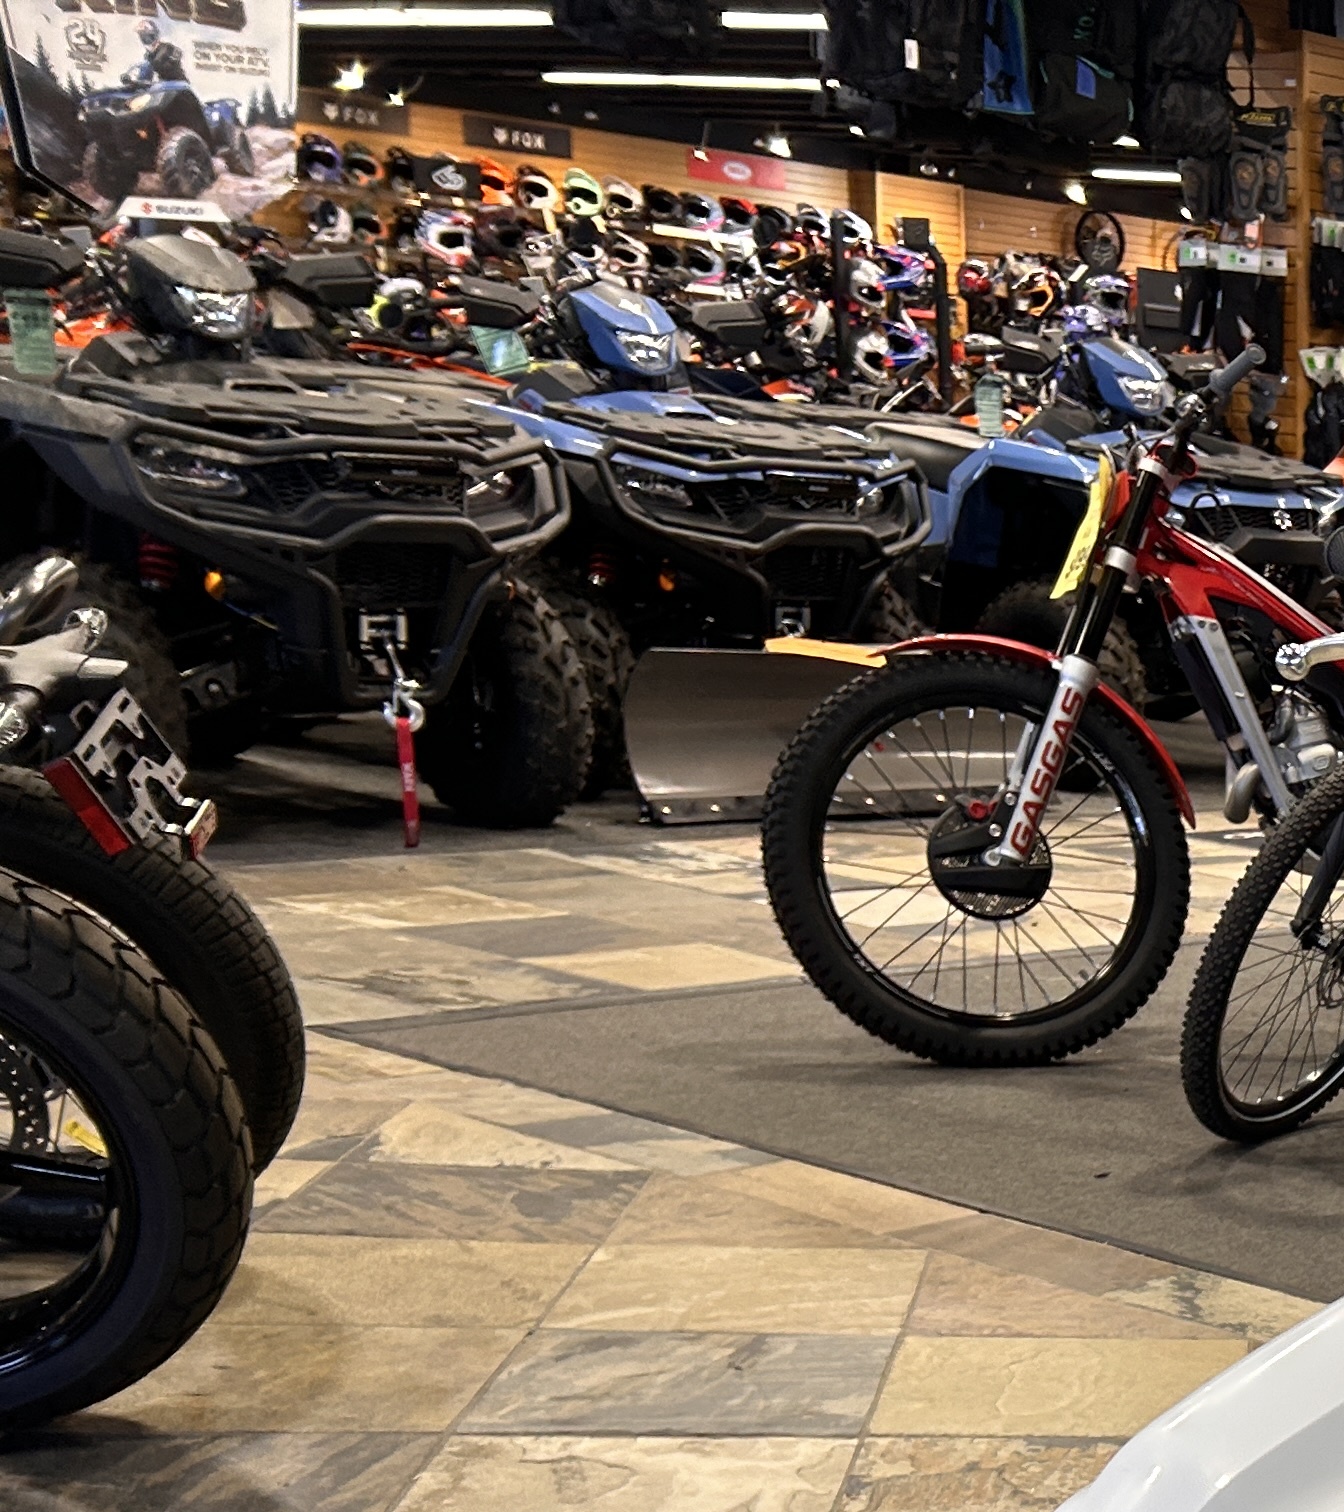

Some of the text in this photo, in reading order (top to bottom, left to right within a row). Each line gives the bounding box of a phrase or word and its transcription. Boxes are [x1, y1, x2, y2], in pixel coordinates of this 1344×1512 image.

[342, 105, 379, 127] FOX
[511, 131, 546, 152] FOX
[155, 204, 204, 216] SUZUKI
[1008, 686, 1086, 858] GASGAS
